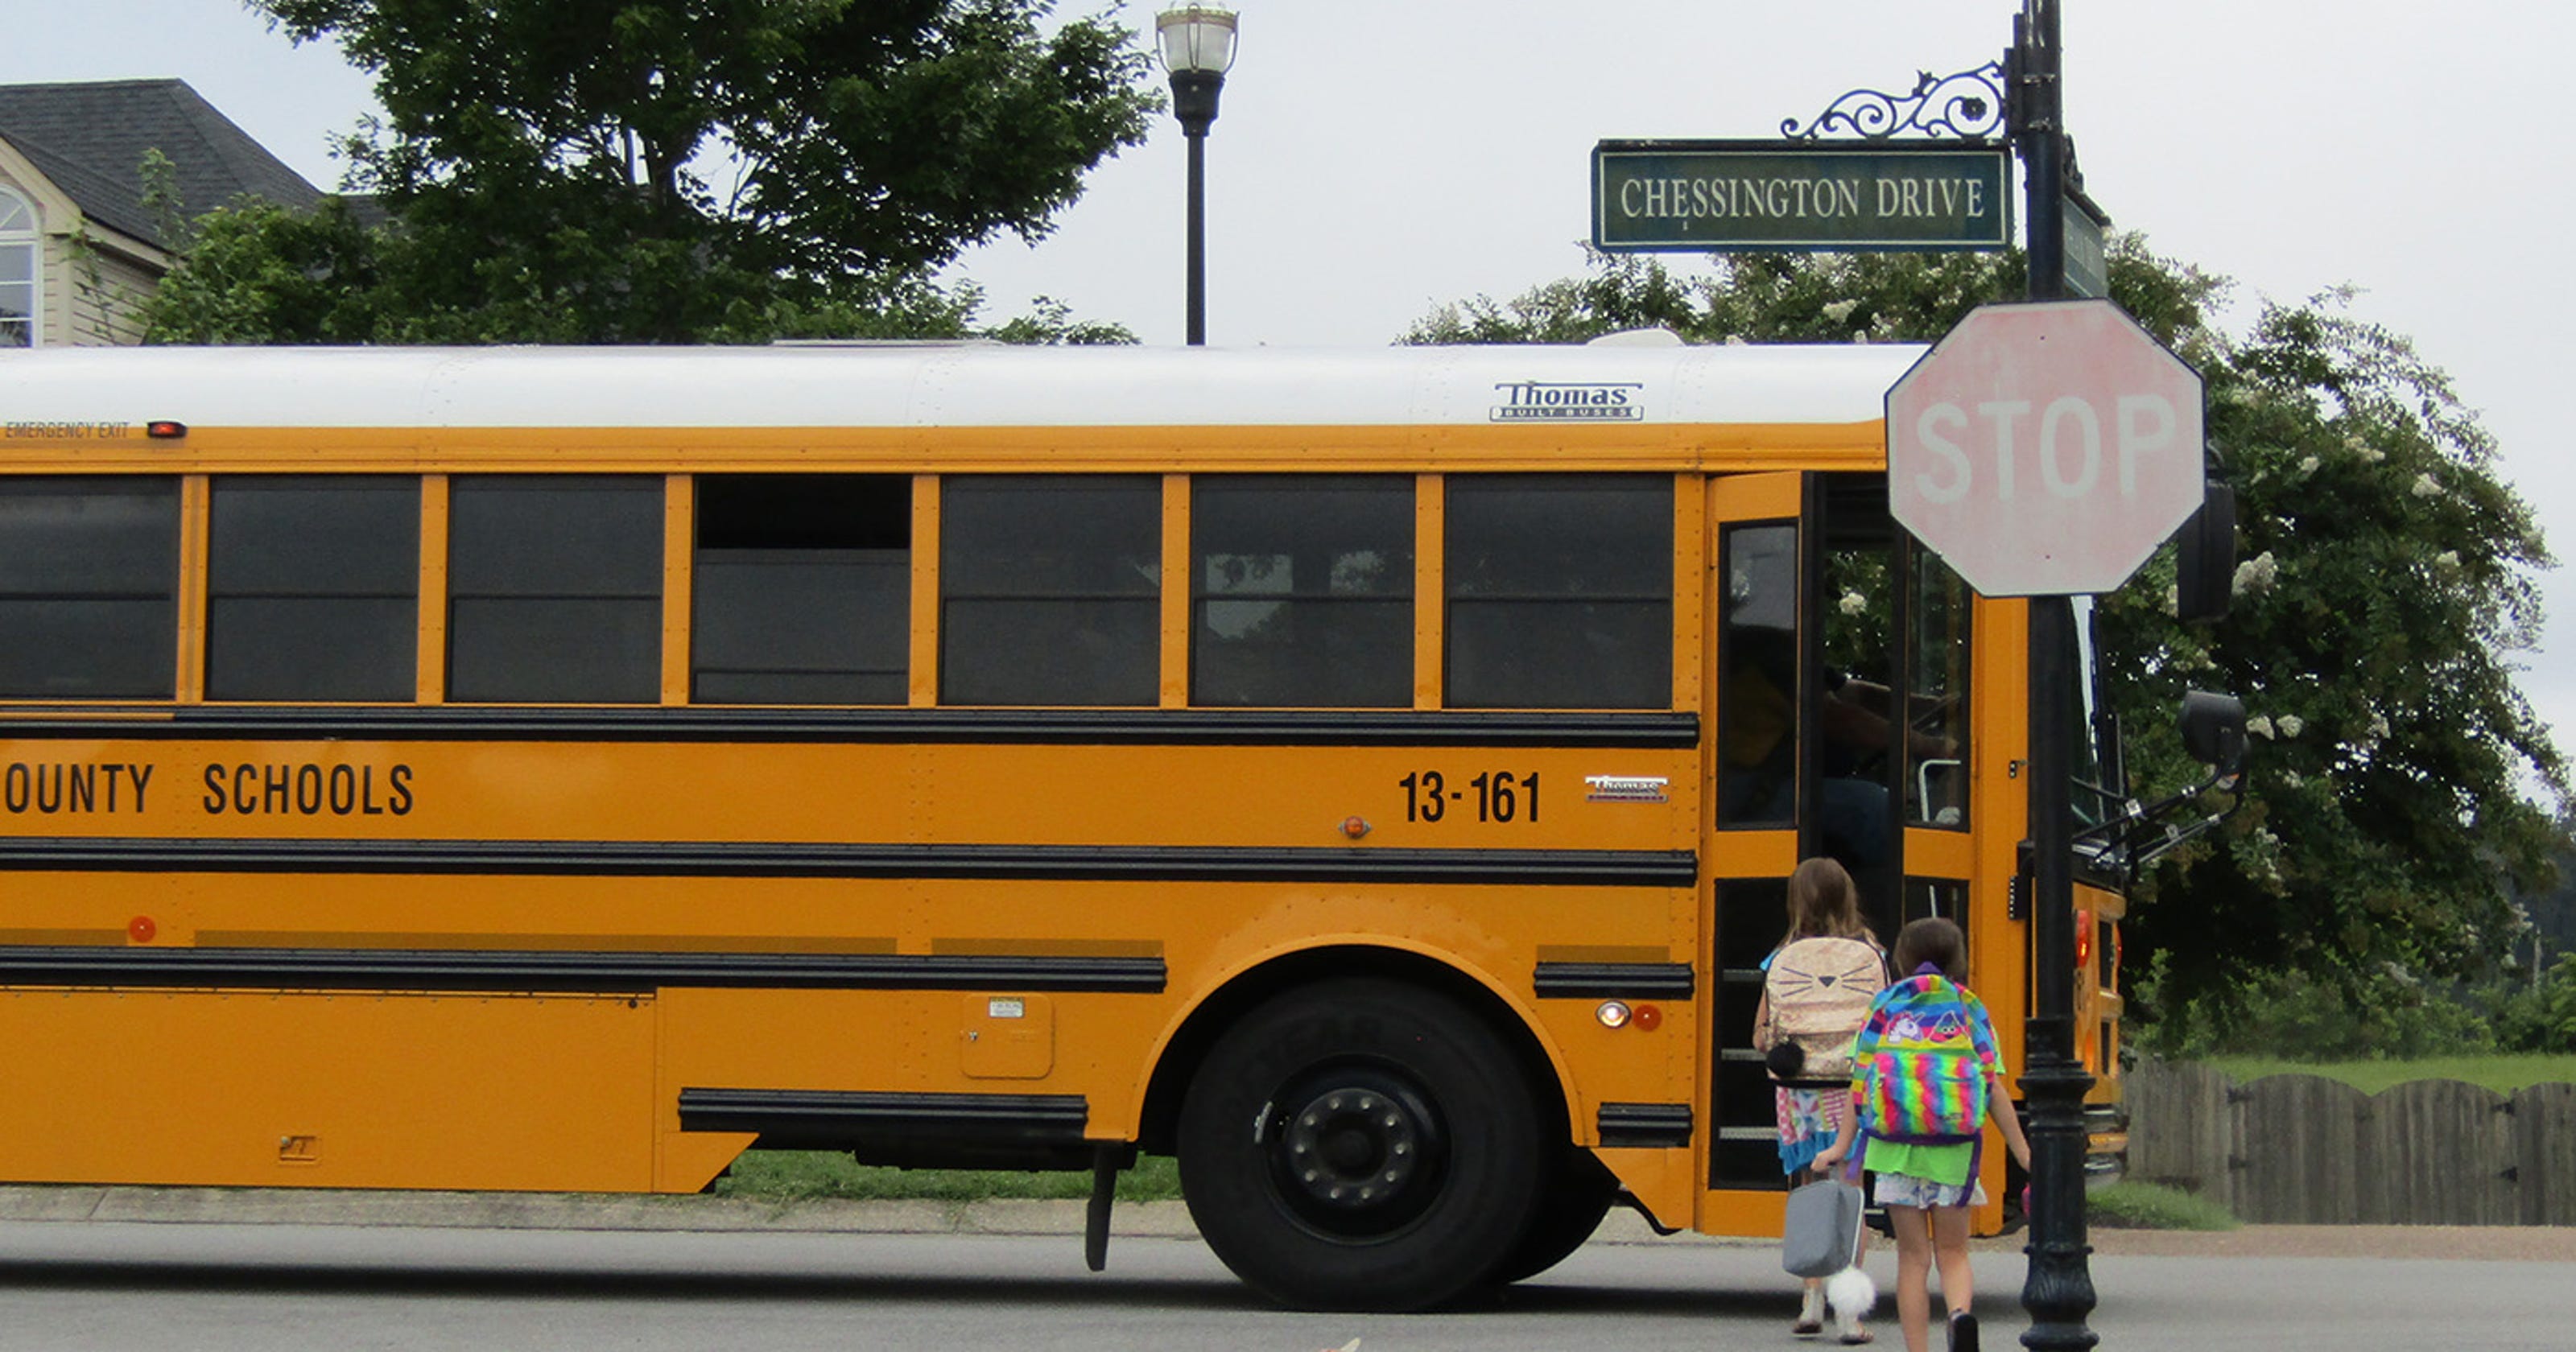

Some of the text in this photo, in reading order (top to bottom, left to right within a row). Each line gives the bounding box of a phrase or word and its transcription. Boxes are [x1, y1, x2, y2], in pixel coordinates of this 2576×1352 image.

[1620, 178, 1985, 218] CHESSINGTON DRIVE
[1495, 380, 1644, 406] Thomas
[1504, 408, 1628, 417] BUILT BUSES
[6, 421, 130, 439] EMERGENCY EXIT
[1914, 393, 2178, 505] STOP
[6, 762, 414, 815] OUNTY SCHOOLS
[1398, 770, 1539, 822] 13-161
